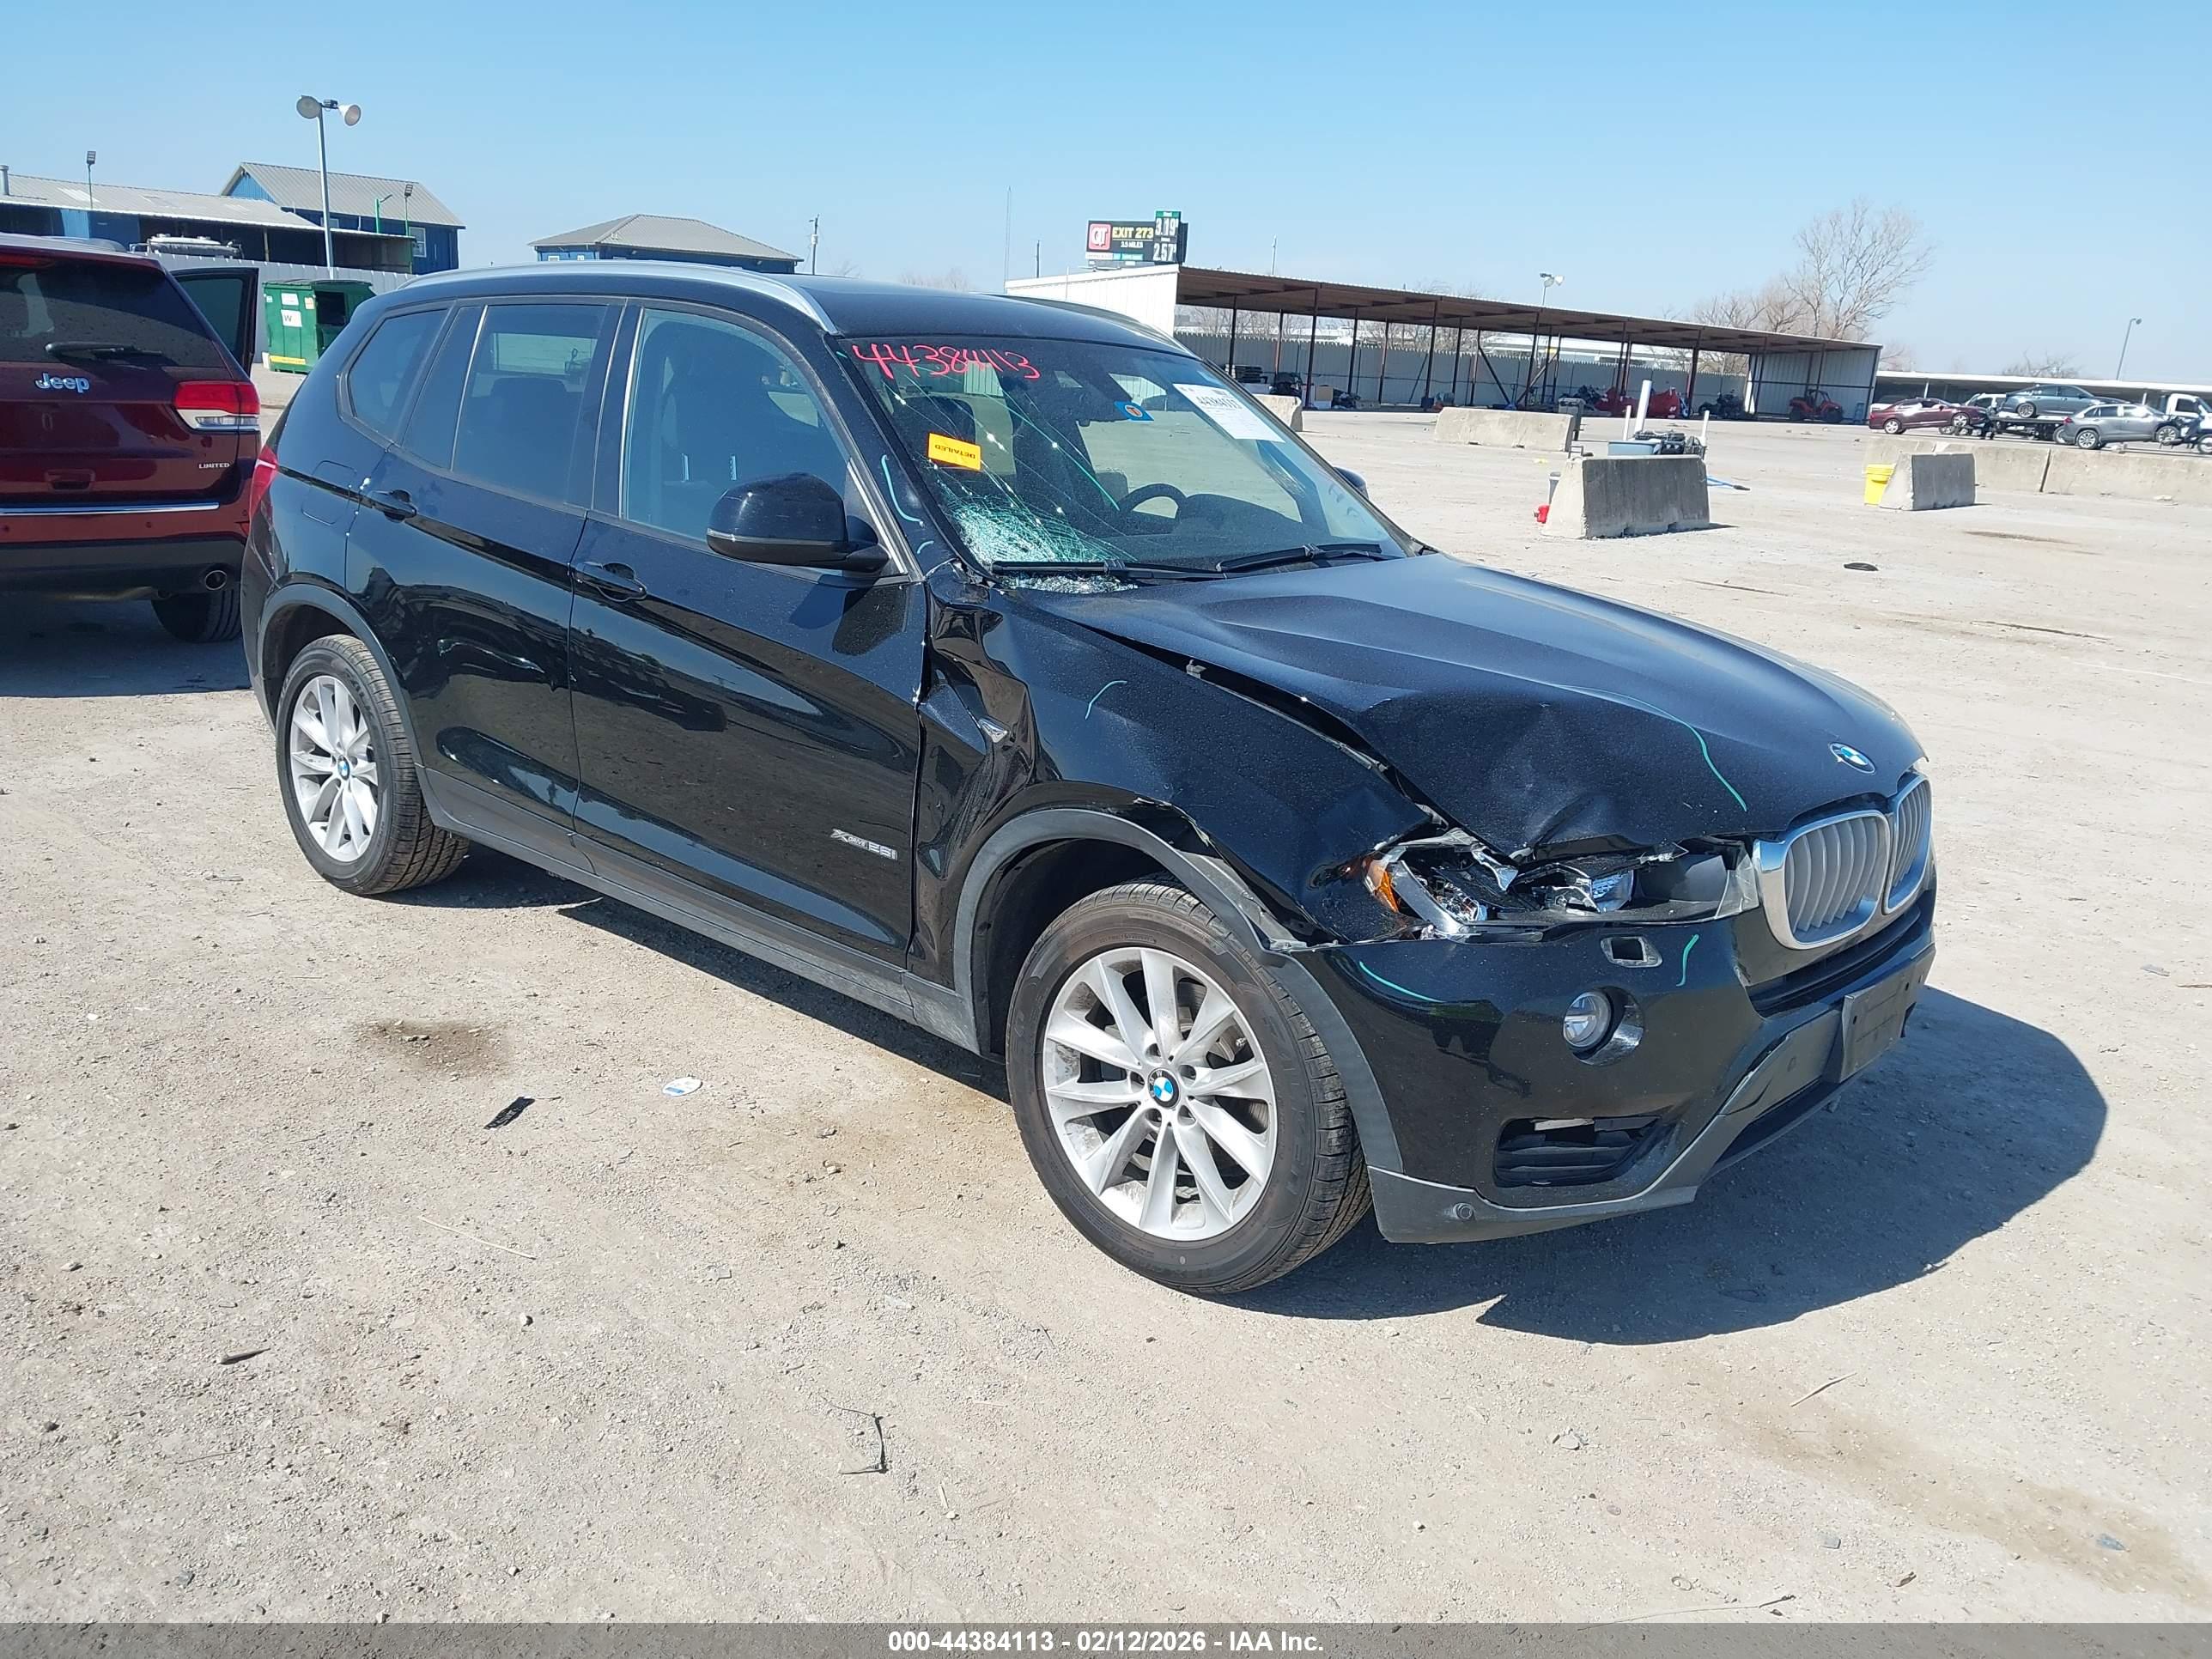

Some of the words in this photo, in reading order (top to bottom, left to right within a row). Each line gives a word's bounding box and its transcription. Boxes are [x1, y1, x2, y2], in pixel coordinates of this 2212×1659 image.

[1091, 226, 1109, 246] QT
[1112, 227, 1134, 239] EXIT
[1135, 227, 1154, 239] 273
[852, 343, 1041, 380] 44384113
[34, 372, 90, 393] Jeep
[934, 444, 976, 459] DETAILED
